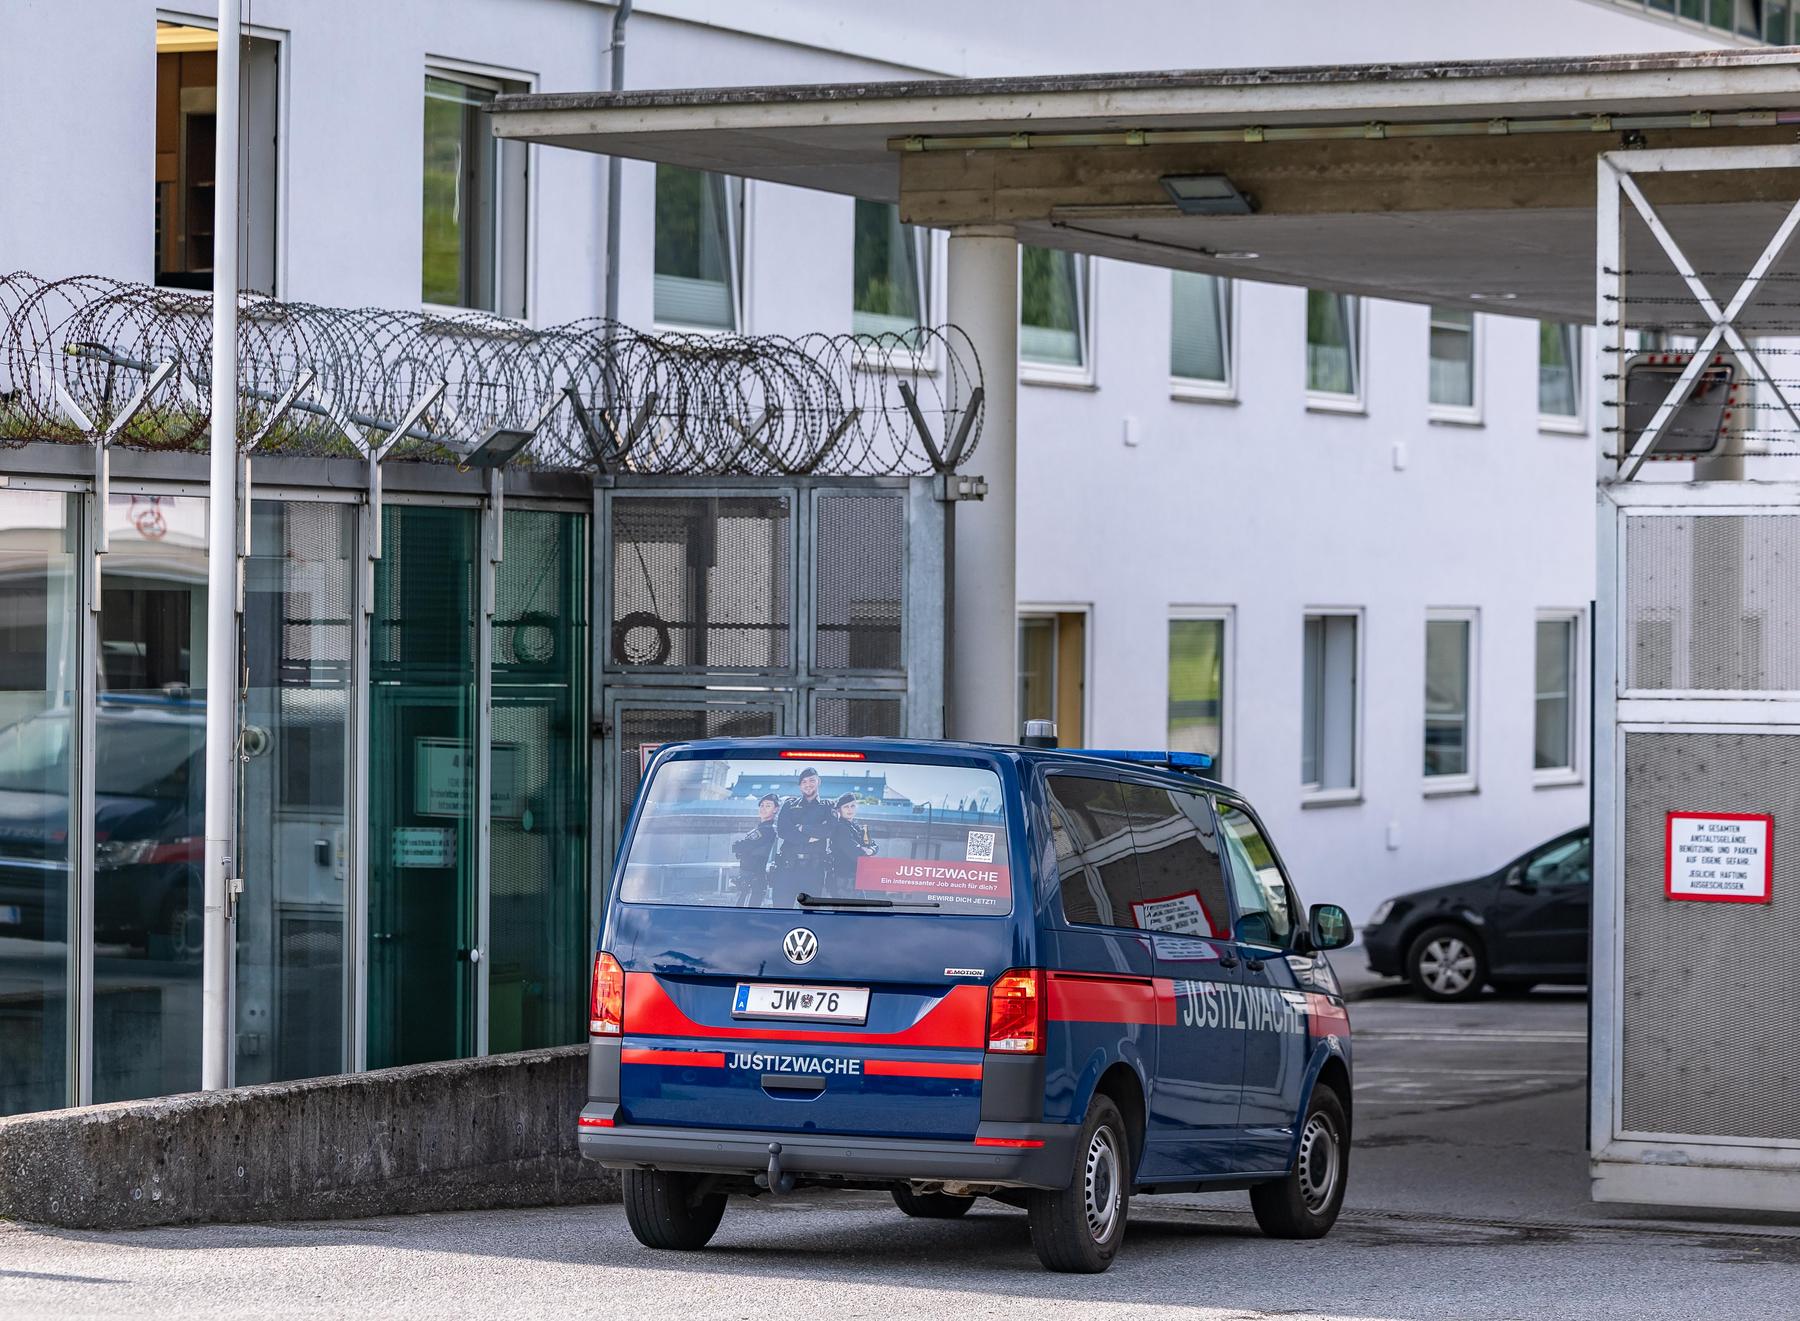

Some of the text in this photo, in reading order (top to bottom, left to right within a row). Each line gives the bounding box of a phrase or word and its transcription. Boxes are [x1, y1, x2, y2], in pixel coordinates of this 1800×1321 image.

[1709, 825, 1740, 833] GESAMTEN
[1718, 846, 1730, 854] UND
[1734, 847, 1758, 855] PARKEN
[1686, 856, 1697, 864] AUF
[896, 865, 999, 881] JUSTIZWACHE
[1689, 870, 1747, 880] JEGLICHE HAFTUNG
[893, 879, 936, 887] interessanter
[968, 882, 977, 890] für
[979, 884, 998, 892] dich?
[955, 896, 972, 904] DICH
[783, 927, 819, 966] VW
[738, 990, 840, 1012] A JW 76
[1184, 979, 1305, 1035] JUSTIZWACHE
[729, 1054, 861, 1076] JUSTIZWACHE
